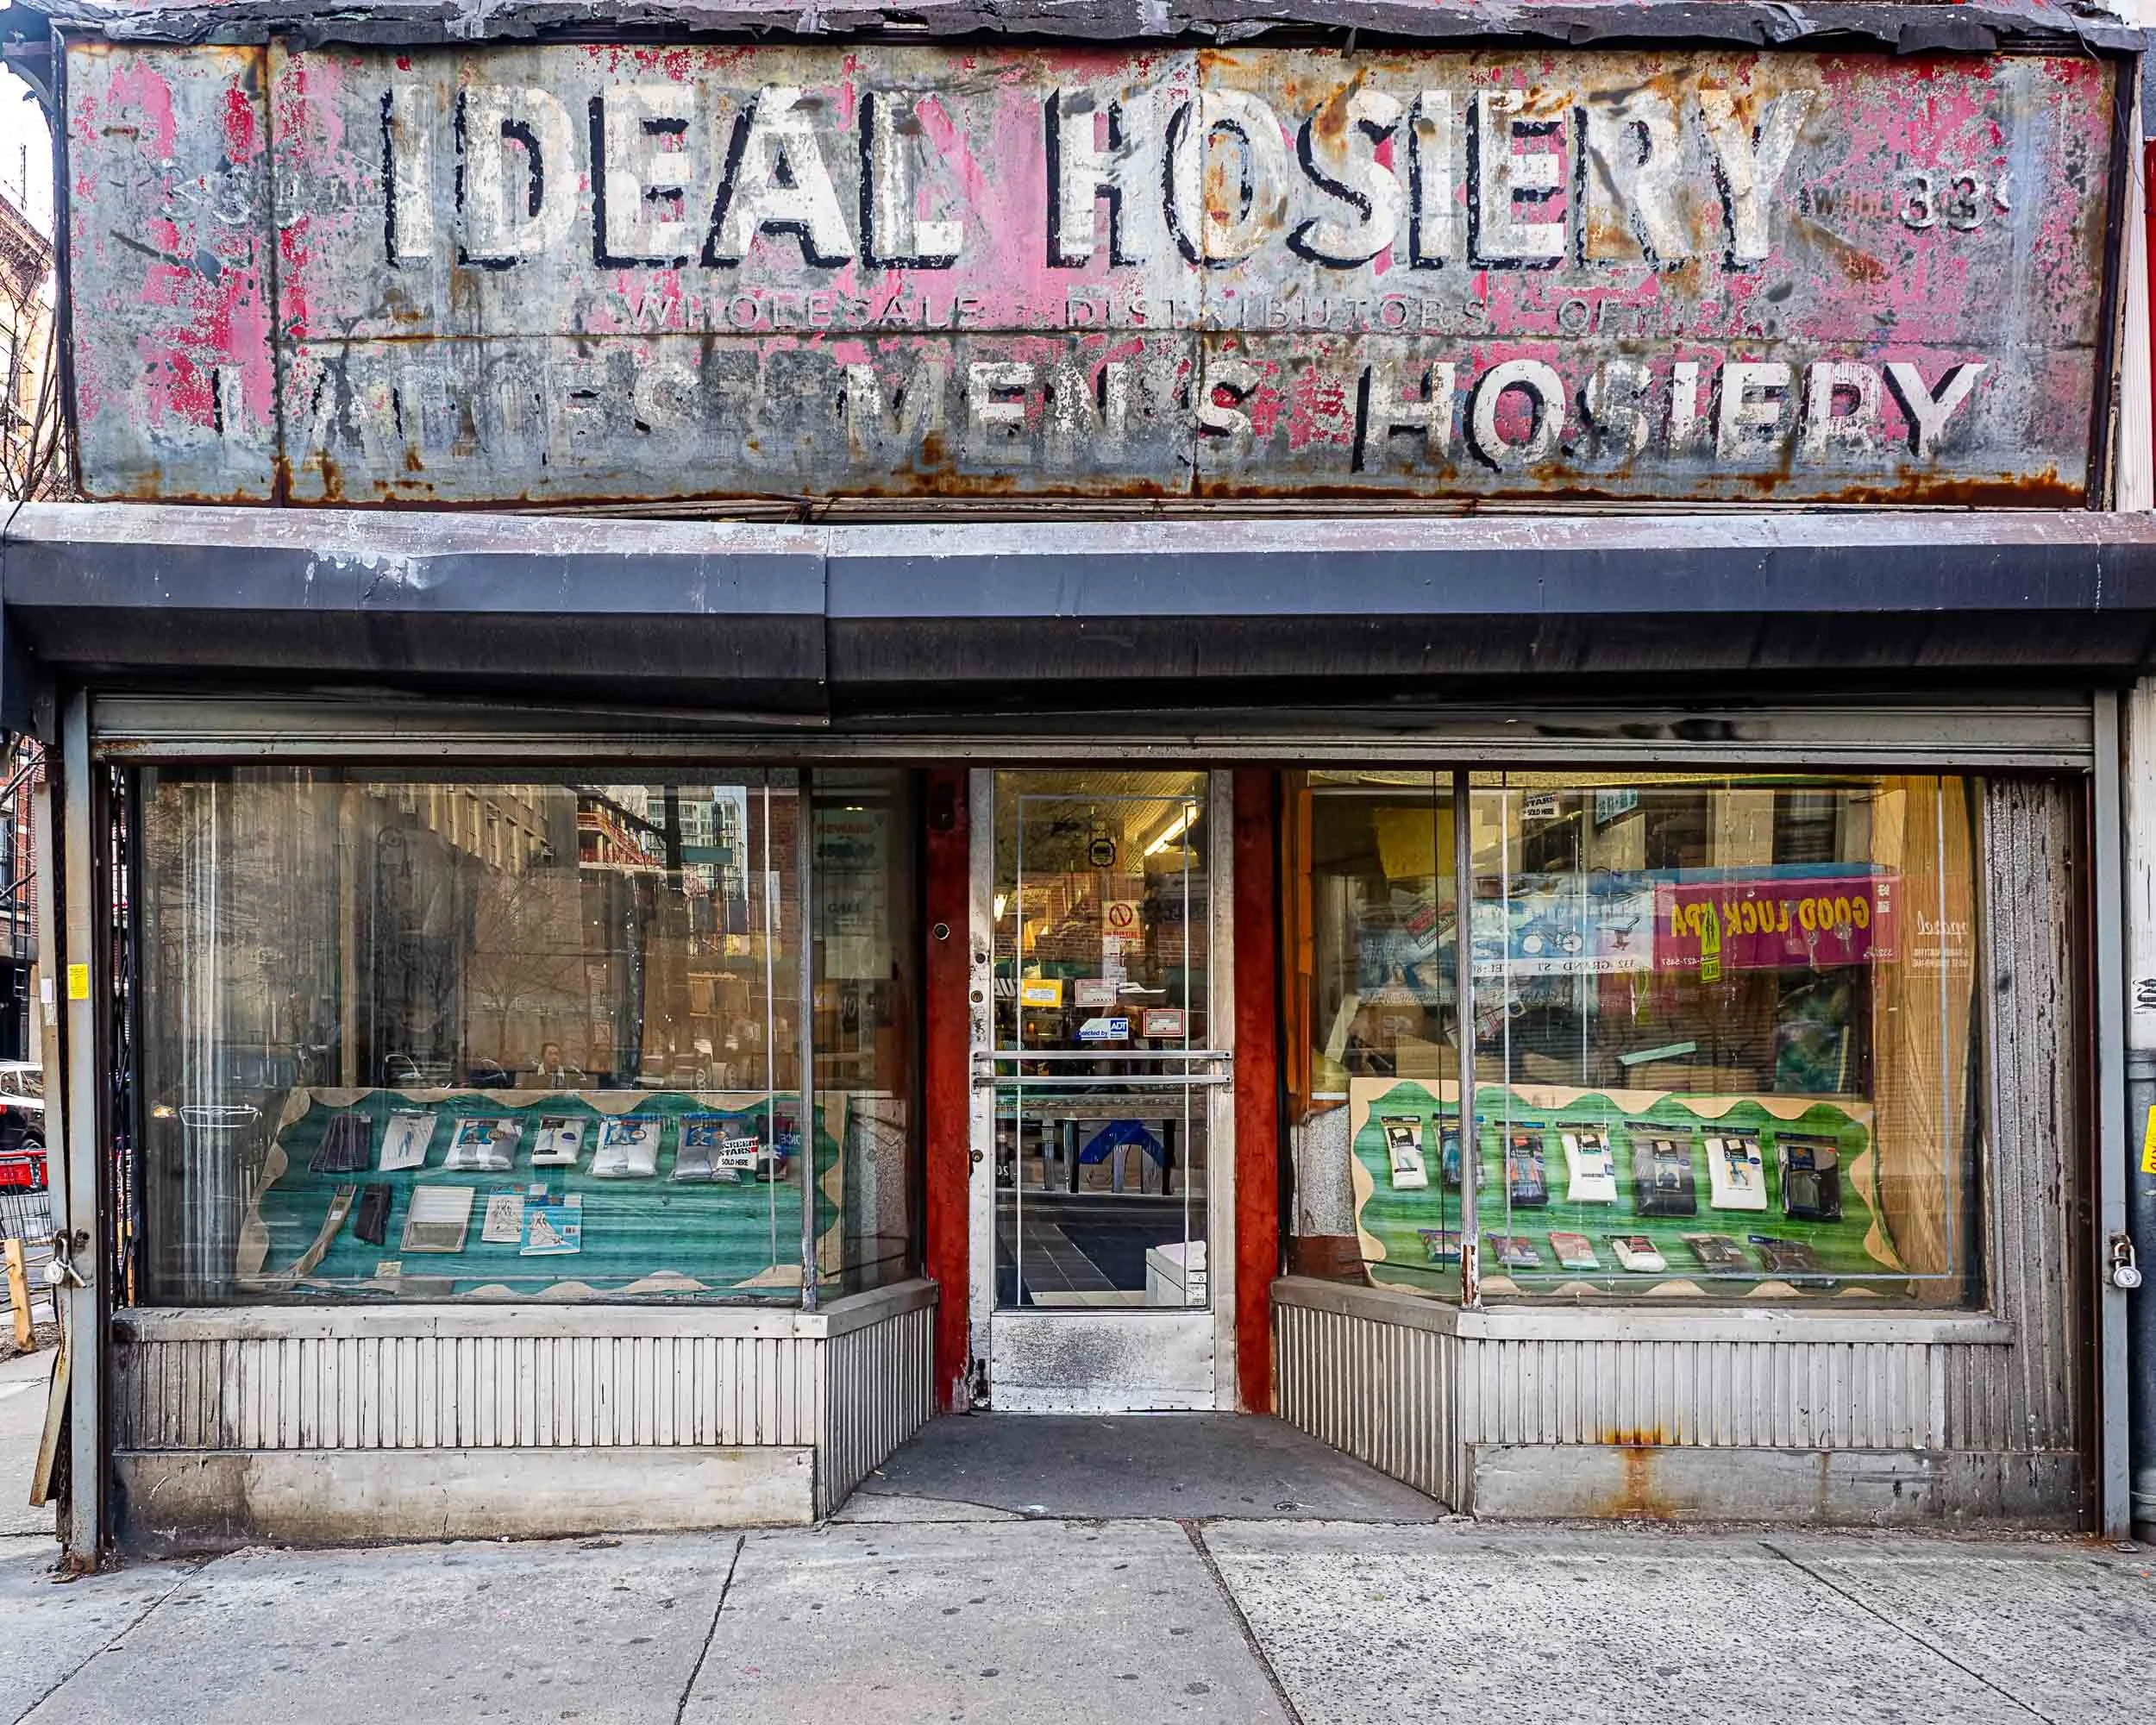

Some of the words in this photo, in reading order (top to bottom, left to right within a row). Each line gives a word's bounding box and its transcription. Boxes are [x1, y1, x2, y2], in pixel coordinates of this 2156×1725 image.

[380, 85, 964, 269] IDEAL
[1045, 85, 1816, 273] HOSIERY
[621, 295, 982, 329] WHOLESALE
[1354, 357, 1988, 473] HOSIERY
[1111, 1021, 1126, 1031] ADT
